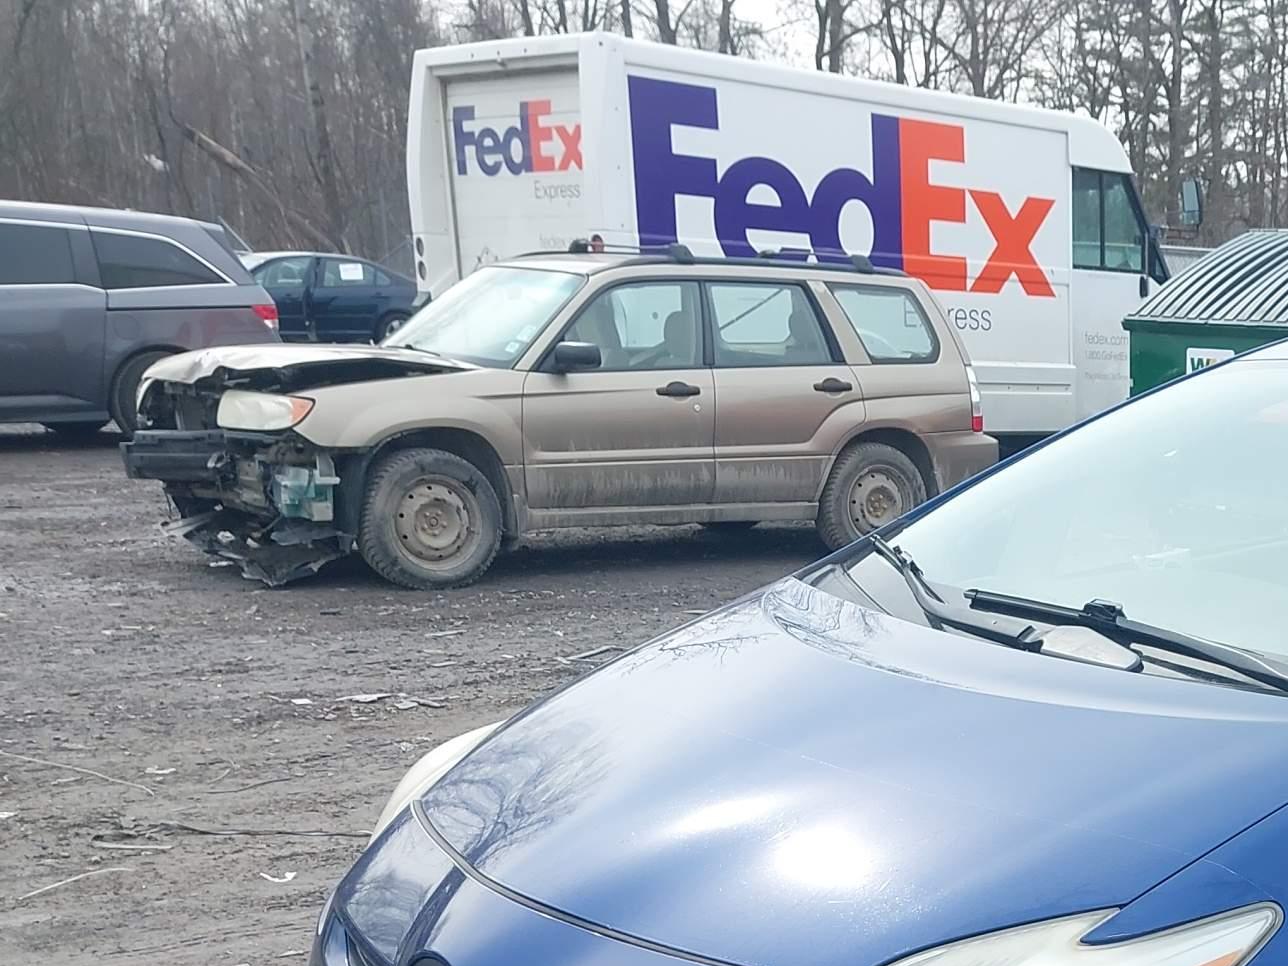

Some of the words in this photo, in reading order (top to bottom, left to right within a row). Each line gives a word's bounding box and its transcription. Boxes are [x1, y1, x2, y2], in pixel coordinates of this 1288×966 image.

[453, 99, 583, 176] FedEx
[534, 181, 581, 202] Express
[628, 74, 1056, 298] FedEx
